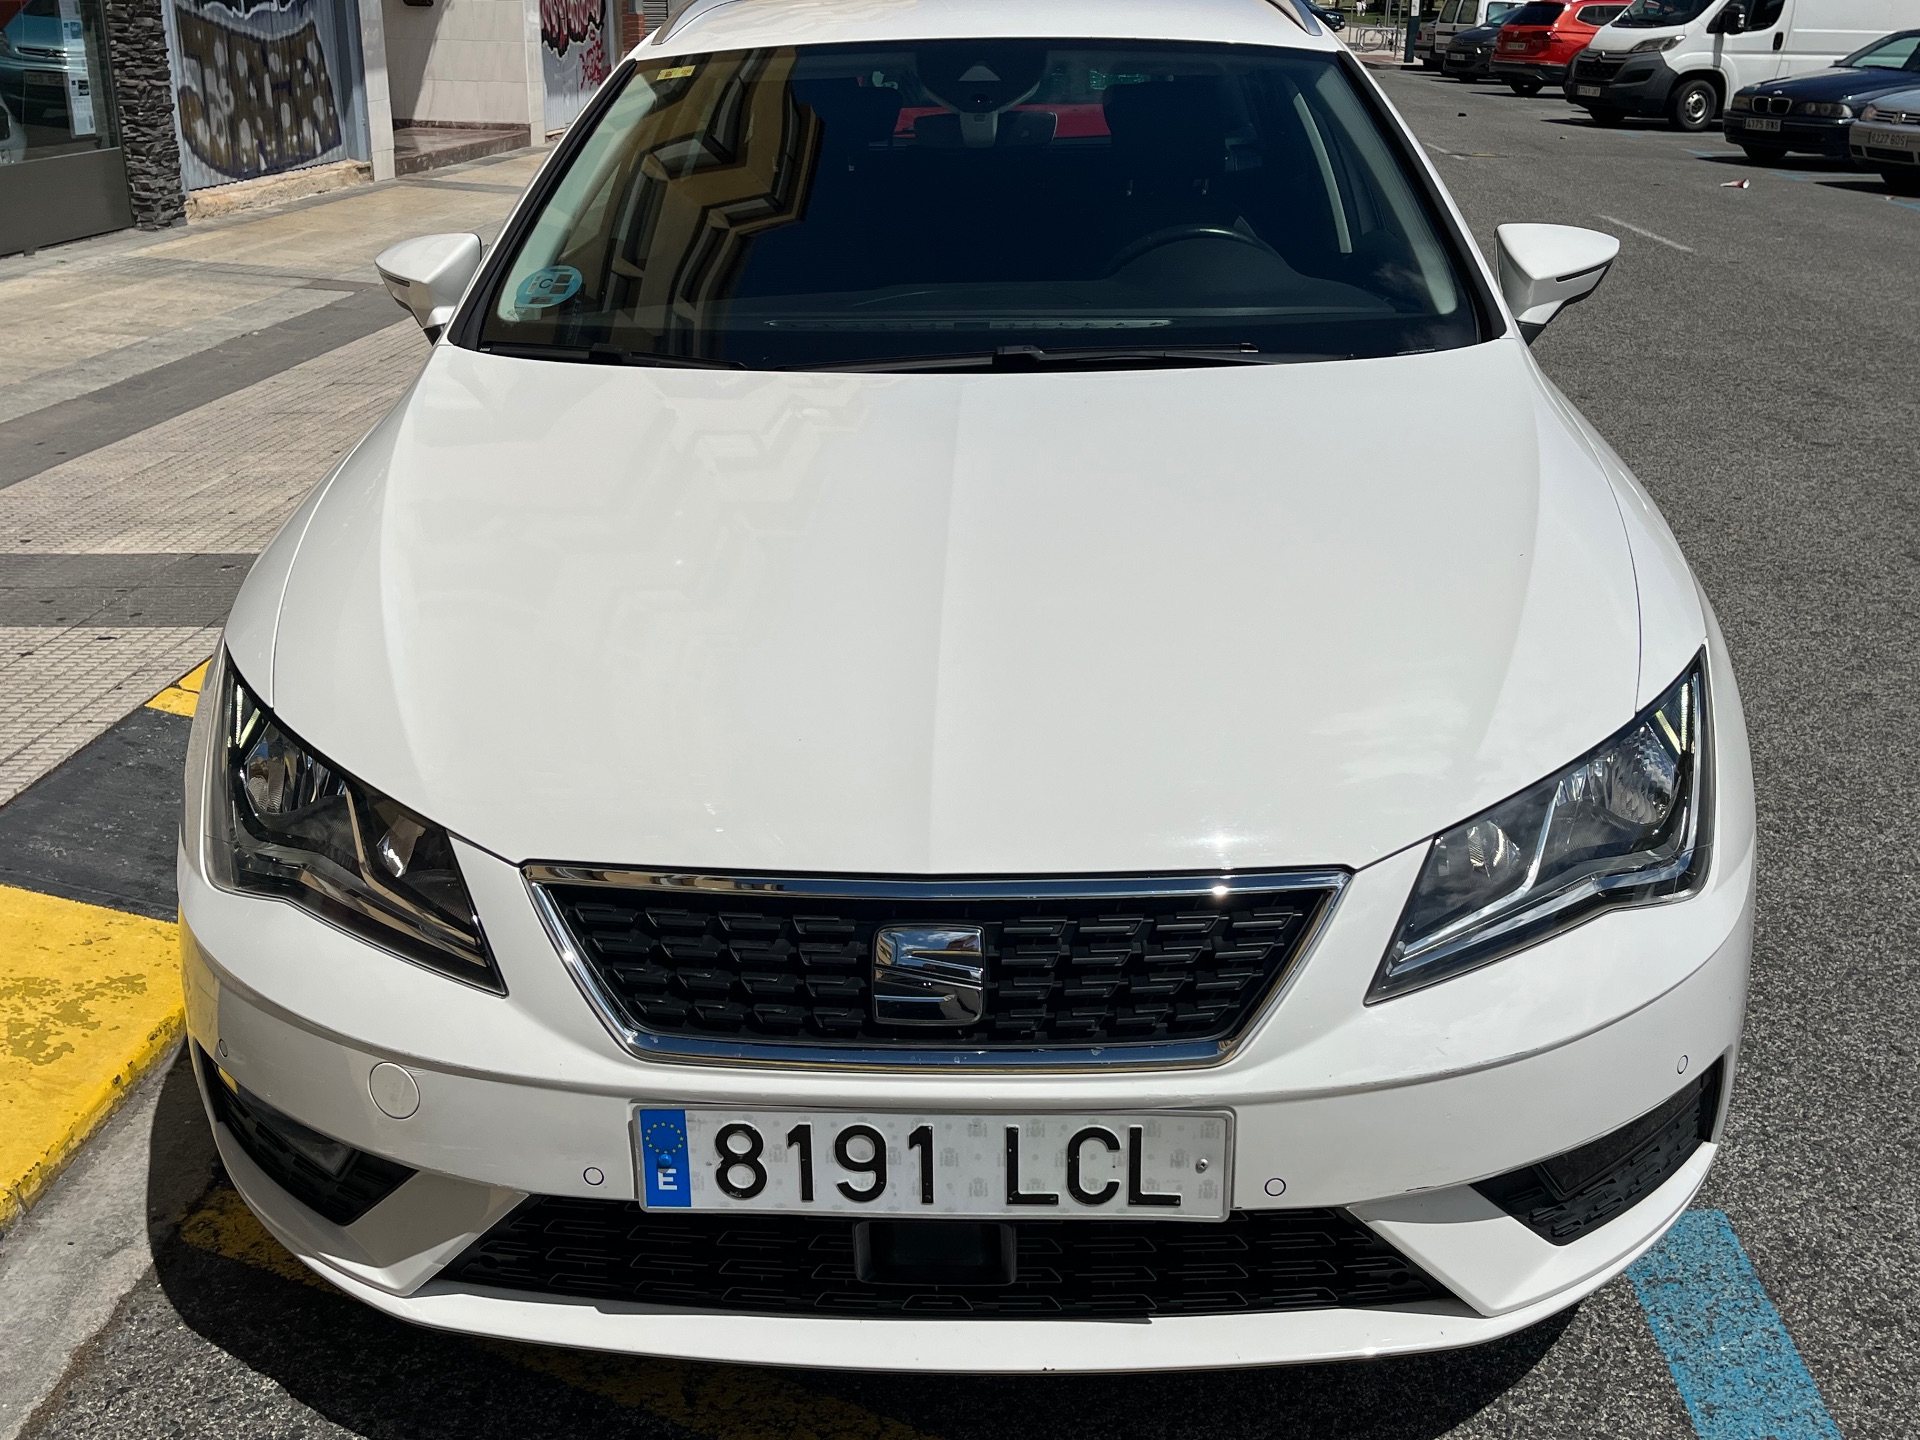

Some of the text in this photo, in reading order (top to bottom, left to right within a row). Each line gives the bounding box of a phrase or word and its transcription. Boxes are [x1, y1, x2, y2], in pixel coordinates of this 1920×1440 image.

[538, 278, 554, 289] C
[715, 1123, 1181, 1206] 8191 LCL
[658, 1168, 678, 1191] E
